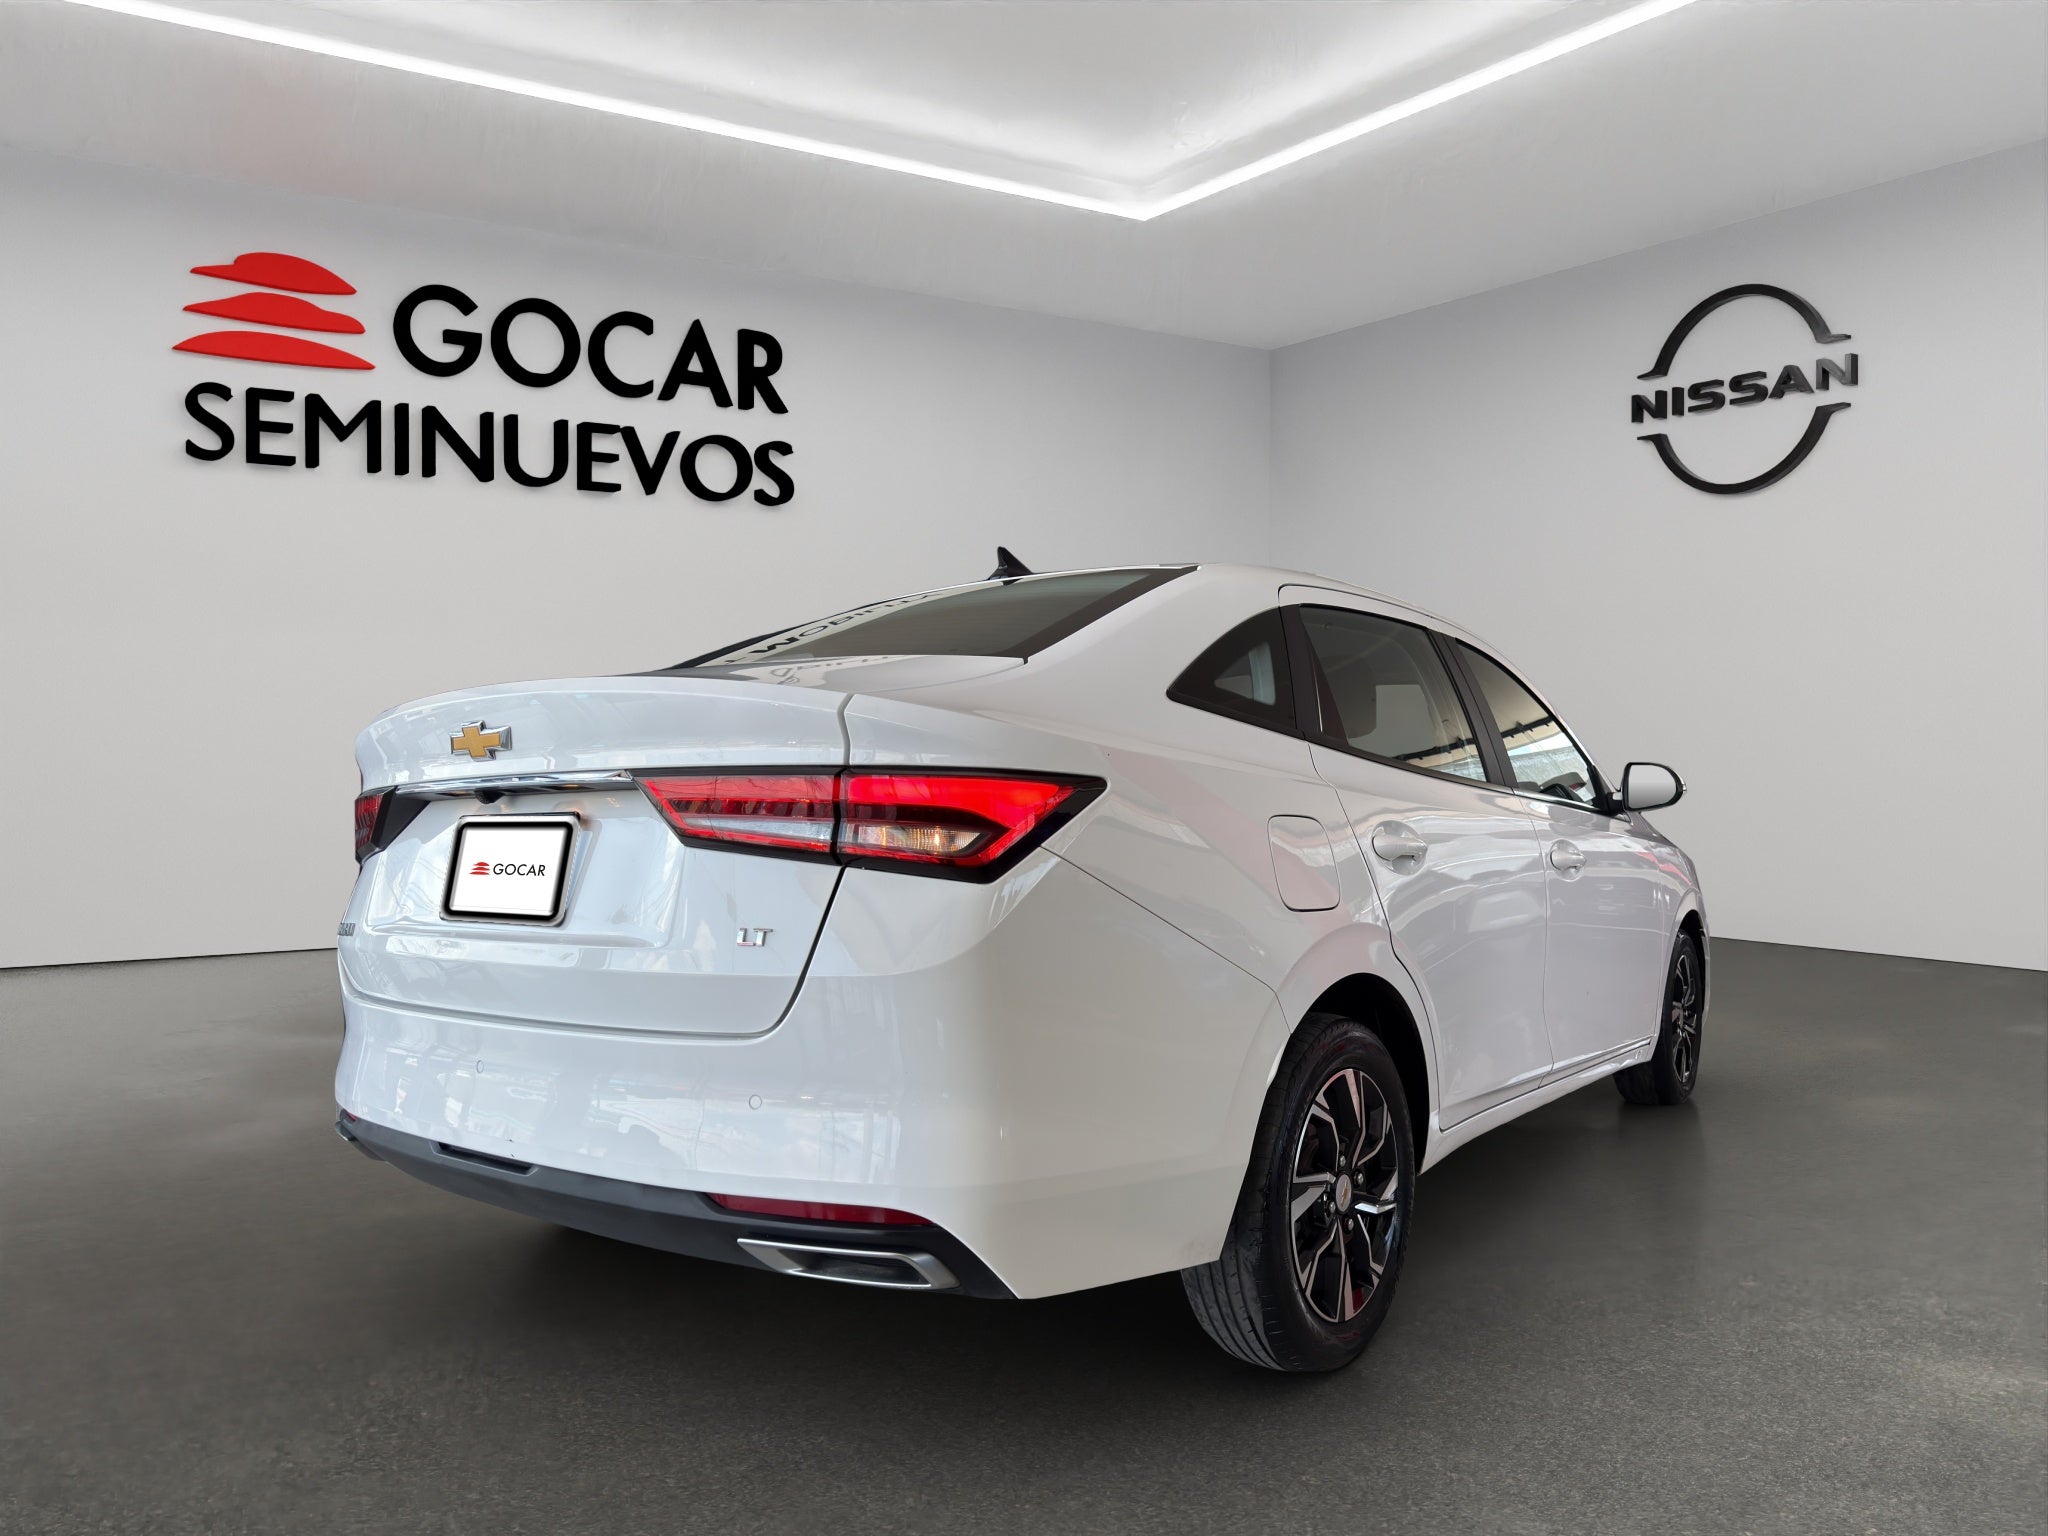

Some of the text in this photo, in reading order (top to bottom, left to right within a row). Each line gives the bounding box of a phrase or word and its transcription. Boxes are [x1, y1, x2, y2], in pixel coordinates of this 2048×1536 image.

[393, 284, 789, 414] GOCAR
[1631, 353, 1858, 423] NISSAN
[184, 382, 795, 506] SEMINUEVOS
[493, 863, 546, 877] GOCAR
[736, 928, 774, 947] LT
